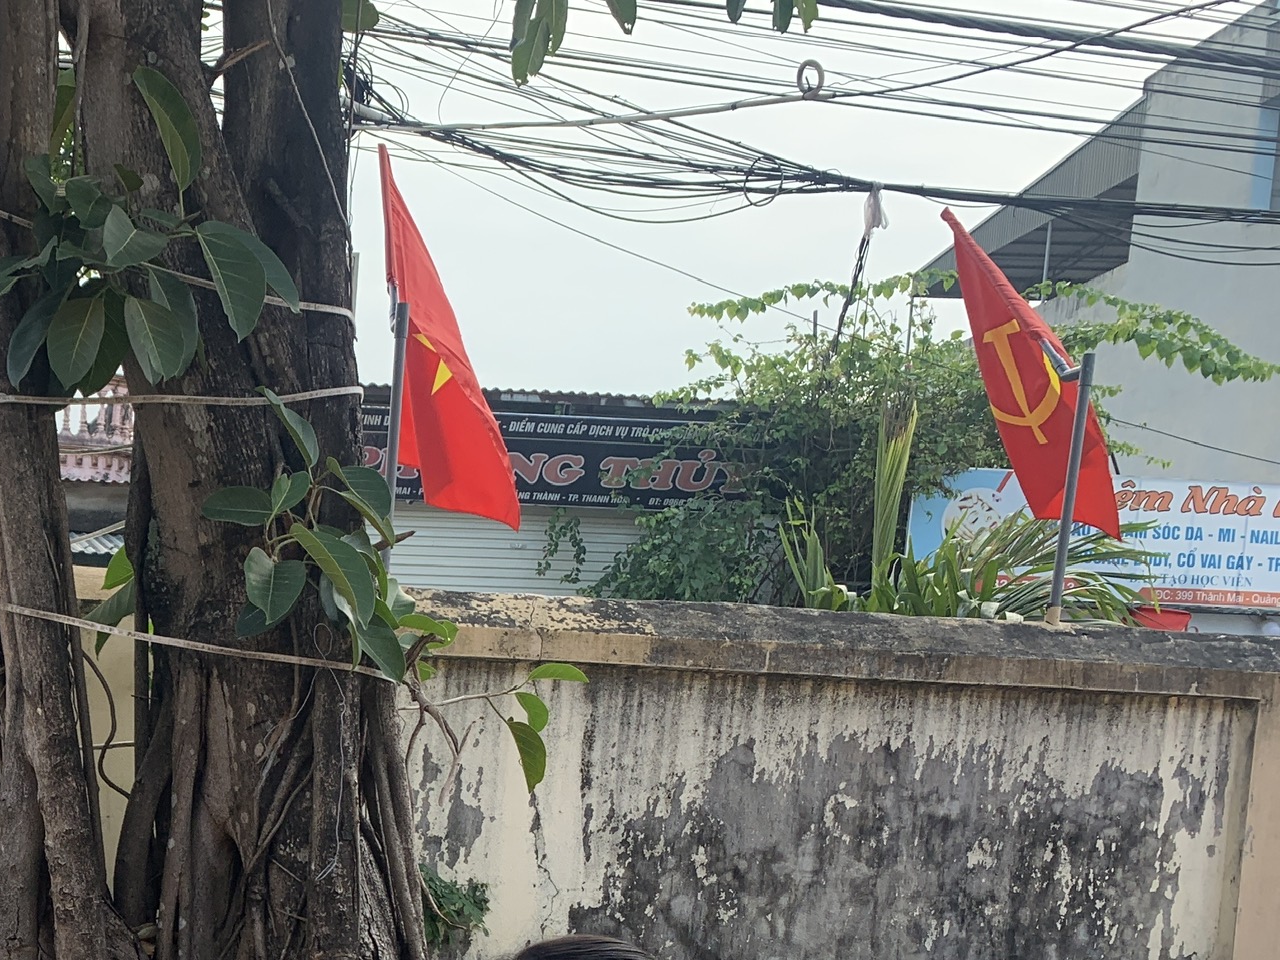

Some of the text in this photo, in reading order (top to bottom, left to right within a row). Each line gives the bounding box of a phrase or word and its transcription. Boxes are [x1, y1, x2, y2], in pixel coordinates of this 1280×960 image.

[361, 414, 382, 426] INH
[509, 418, 535, 433] ĐIỂM
[536, 422, 565, 434] CUNG
[566, 420, 587, 436] CẤP
[589, 425, 613, 438] DỊCH
[614, 426, 629, 439] VỤ
[532, 491, 560, 501] THÀNH
[582, 494, 610, 504] THANH
[1180, 485, 1267, 517] Nhà
[1152, 522, 1181, 541] SÓC
[1185, 526, 1204, 541] DA
[1217, 528, 1236, 543] MI
[1249, 529, 1280, 545] NAIL
[1177, 547, 1198, 568] CỔ
[1201, 553, 1222, 569] VAI
[1226, 552, 1254, 571] GÁY
[1190, 574, 1220, 588] HỌC
[1222, 573, 1253, 587] VIÊN
[1176, 590, 1194, 600] 399
[1227, 592, 1244, 603] Mai
